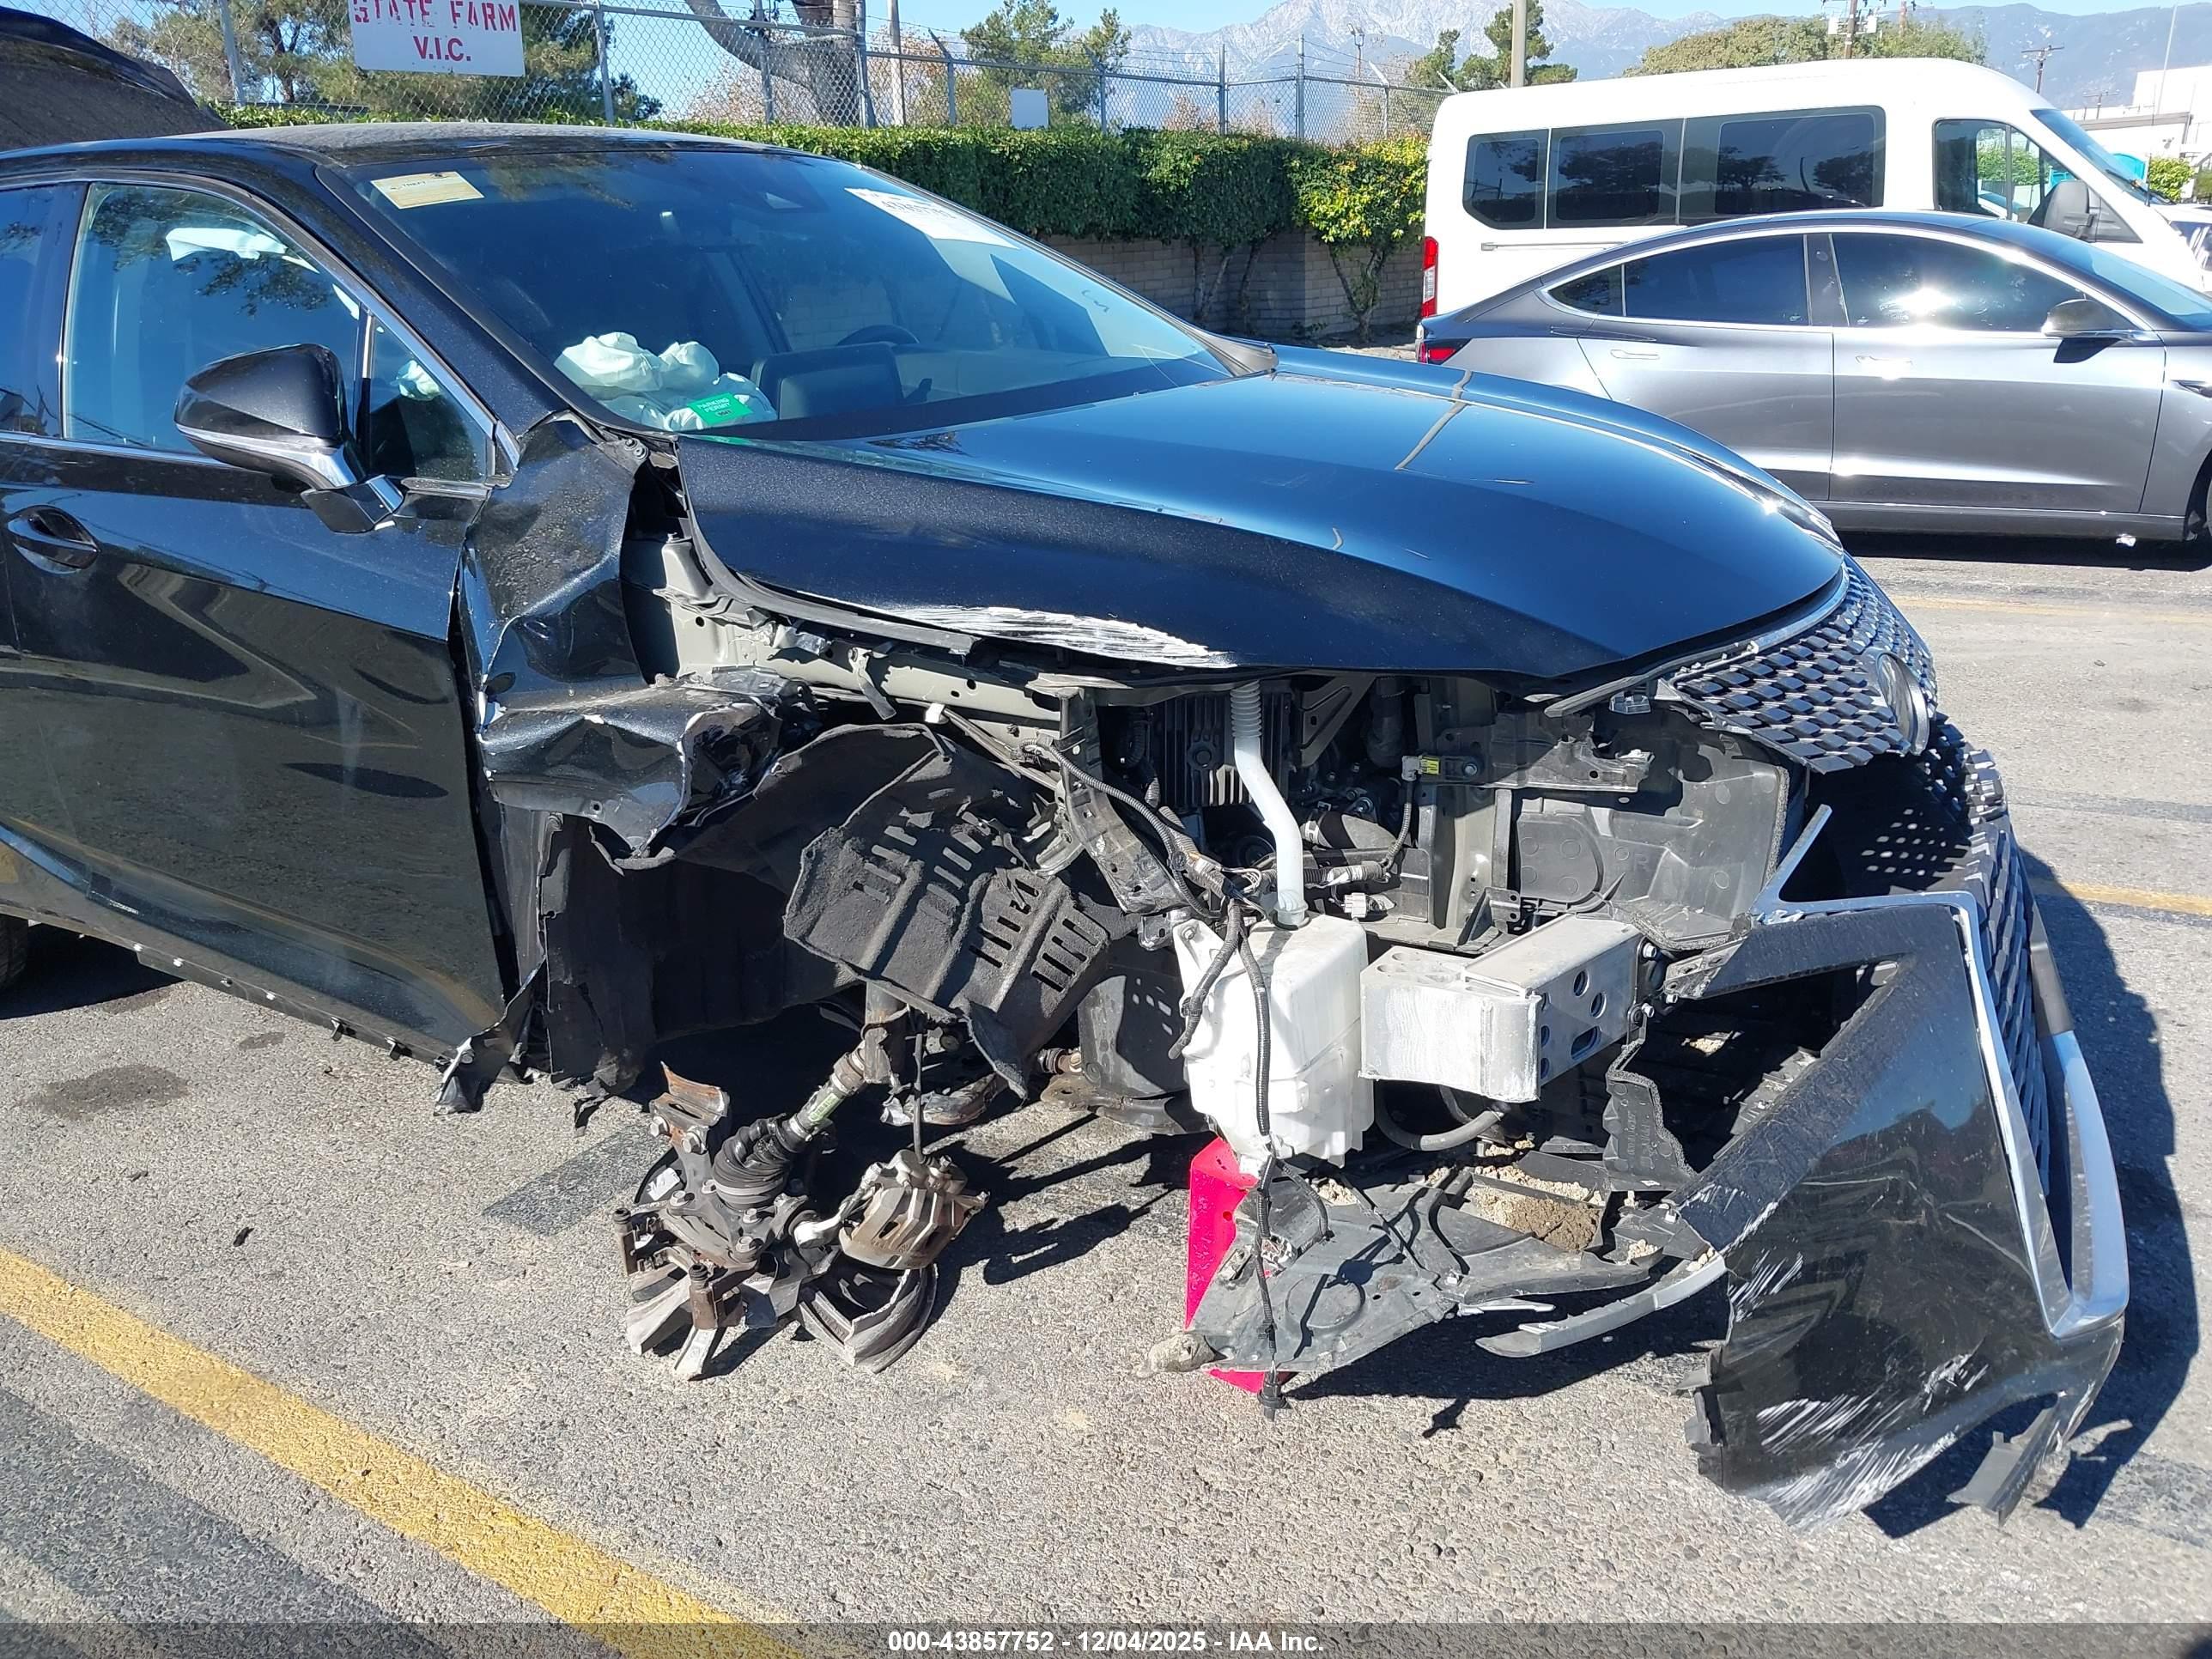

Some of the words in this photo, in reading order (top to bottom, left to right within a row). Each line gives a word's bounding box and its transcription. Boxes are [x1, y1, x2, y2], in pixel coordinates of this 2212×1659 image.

[354, 0, 434, 27] STATE
[450, 1, 517, 32] FARM
[413, 36, 471, 62] V.I.C.
[696, 398, 730, 410] PARKING
[704, 403, 730, 412] PERMIT
